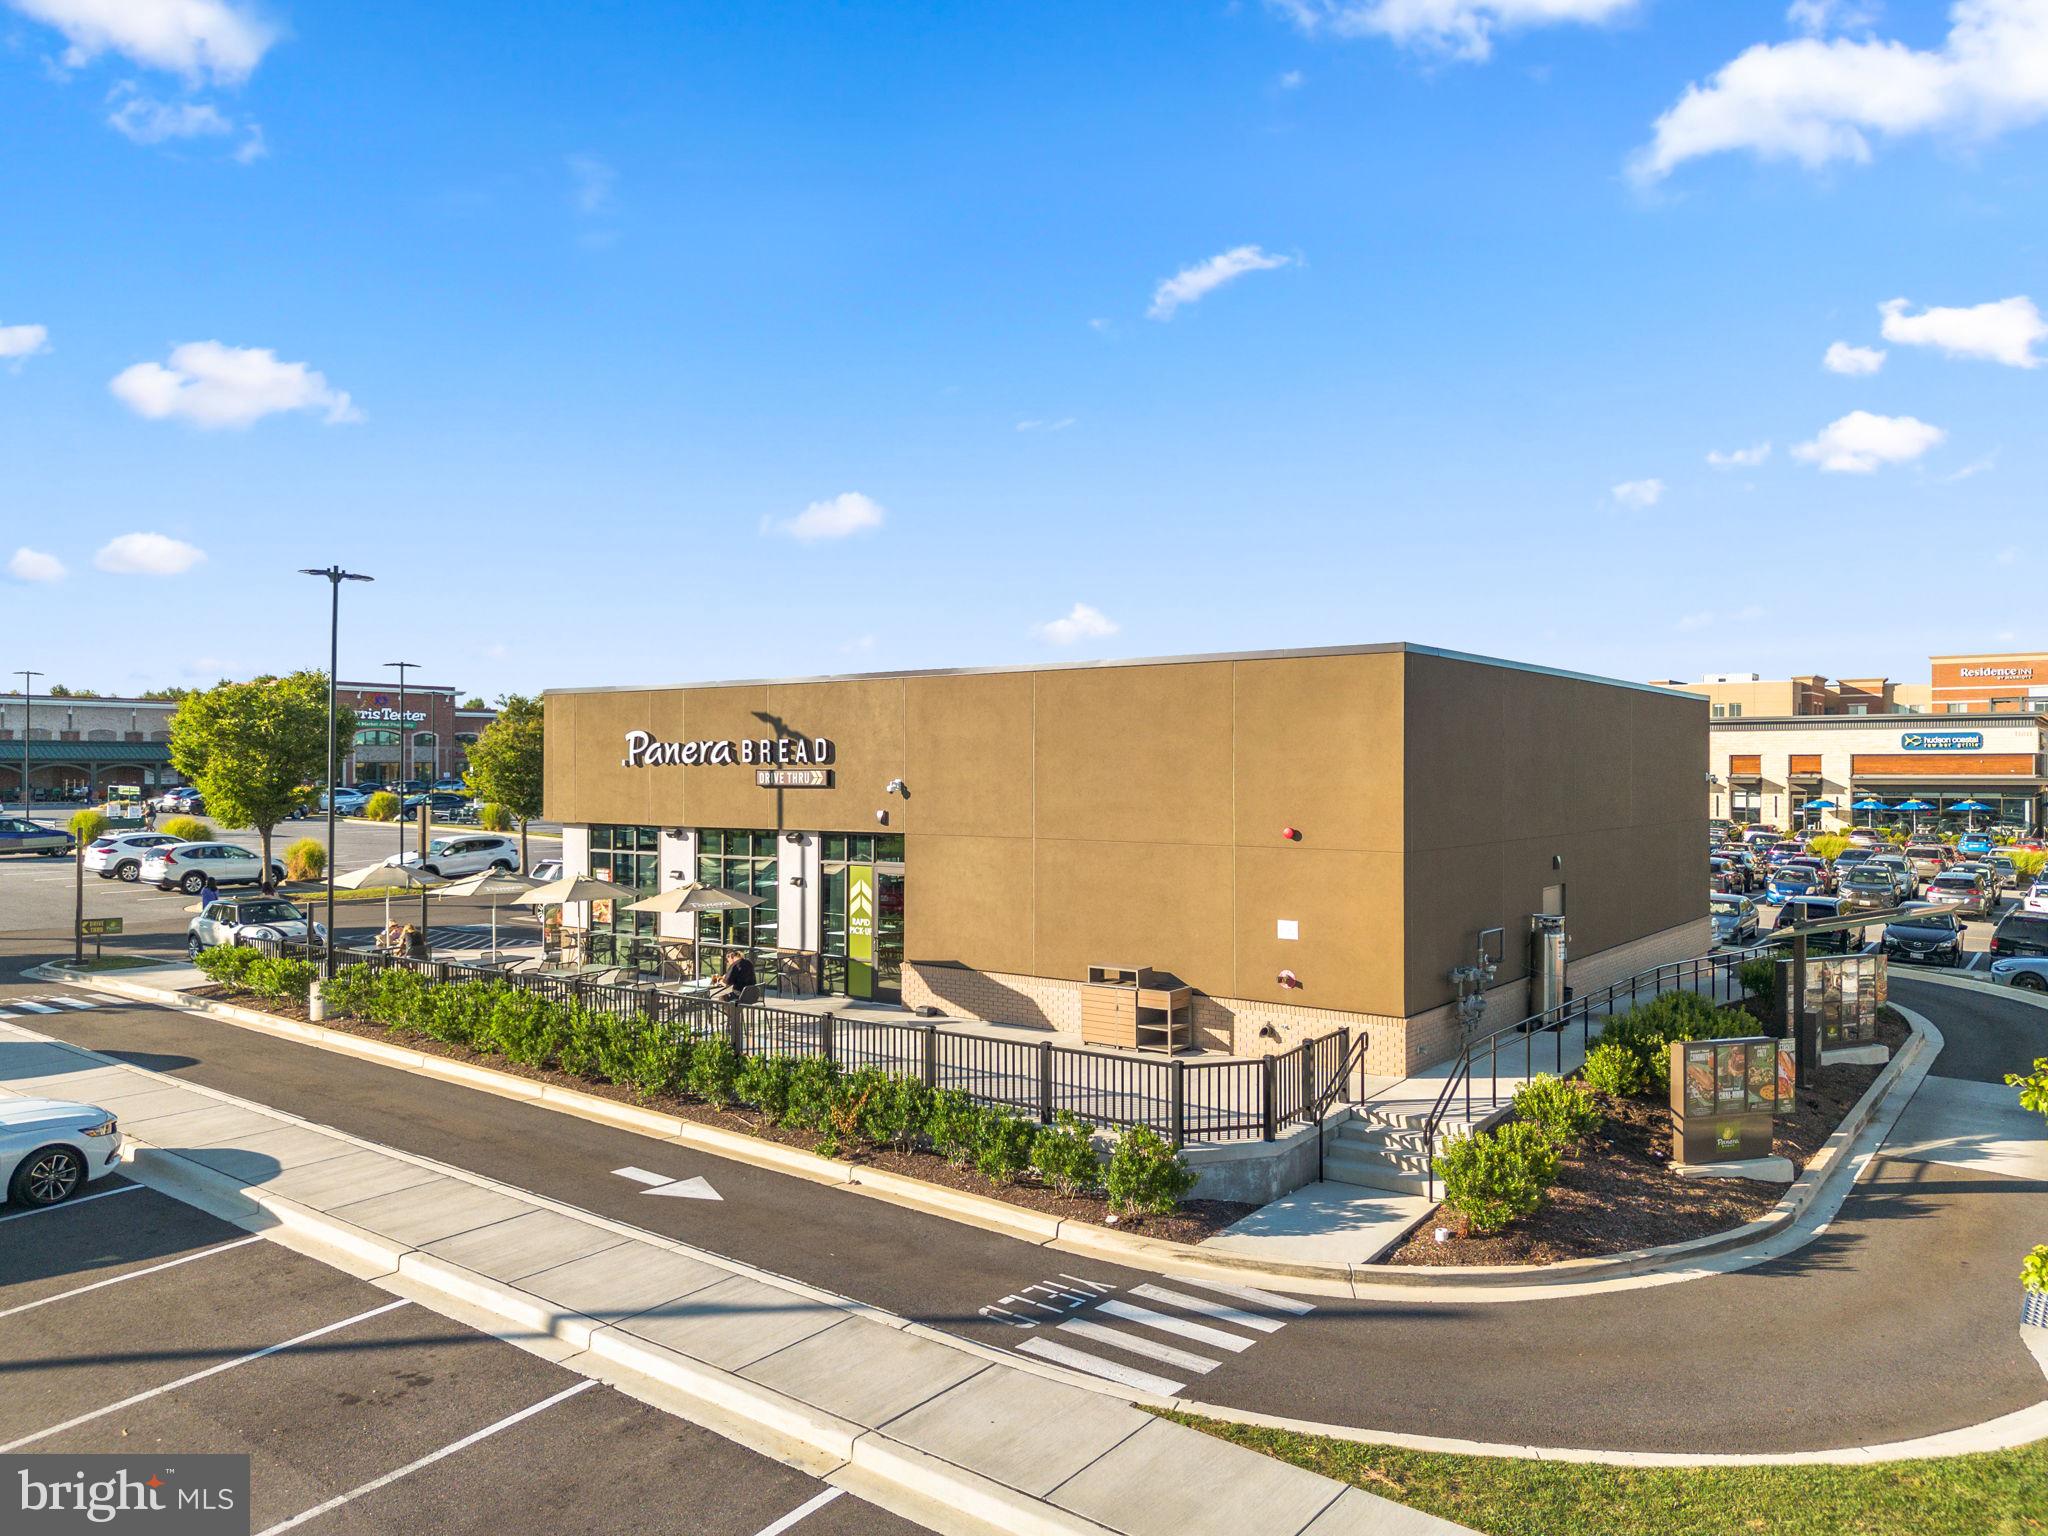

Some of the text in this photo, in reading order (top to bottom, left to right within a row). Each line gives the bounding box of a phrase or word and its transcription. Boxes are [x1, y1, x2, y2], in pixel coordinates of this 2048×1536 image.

[1960, 668, 2017, 676] Residence
[1952, 735, 1980, 743] coastal
[625, 730, 828, 765] Panera BREAD
[759, 772, 810, 784] DRIVE THRU
[851, 918, 870, 926] RAPID
[977, 1273, 1117, 1329] YIELD
